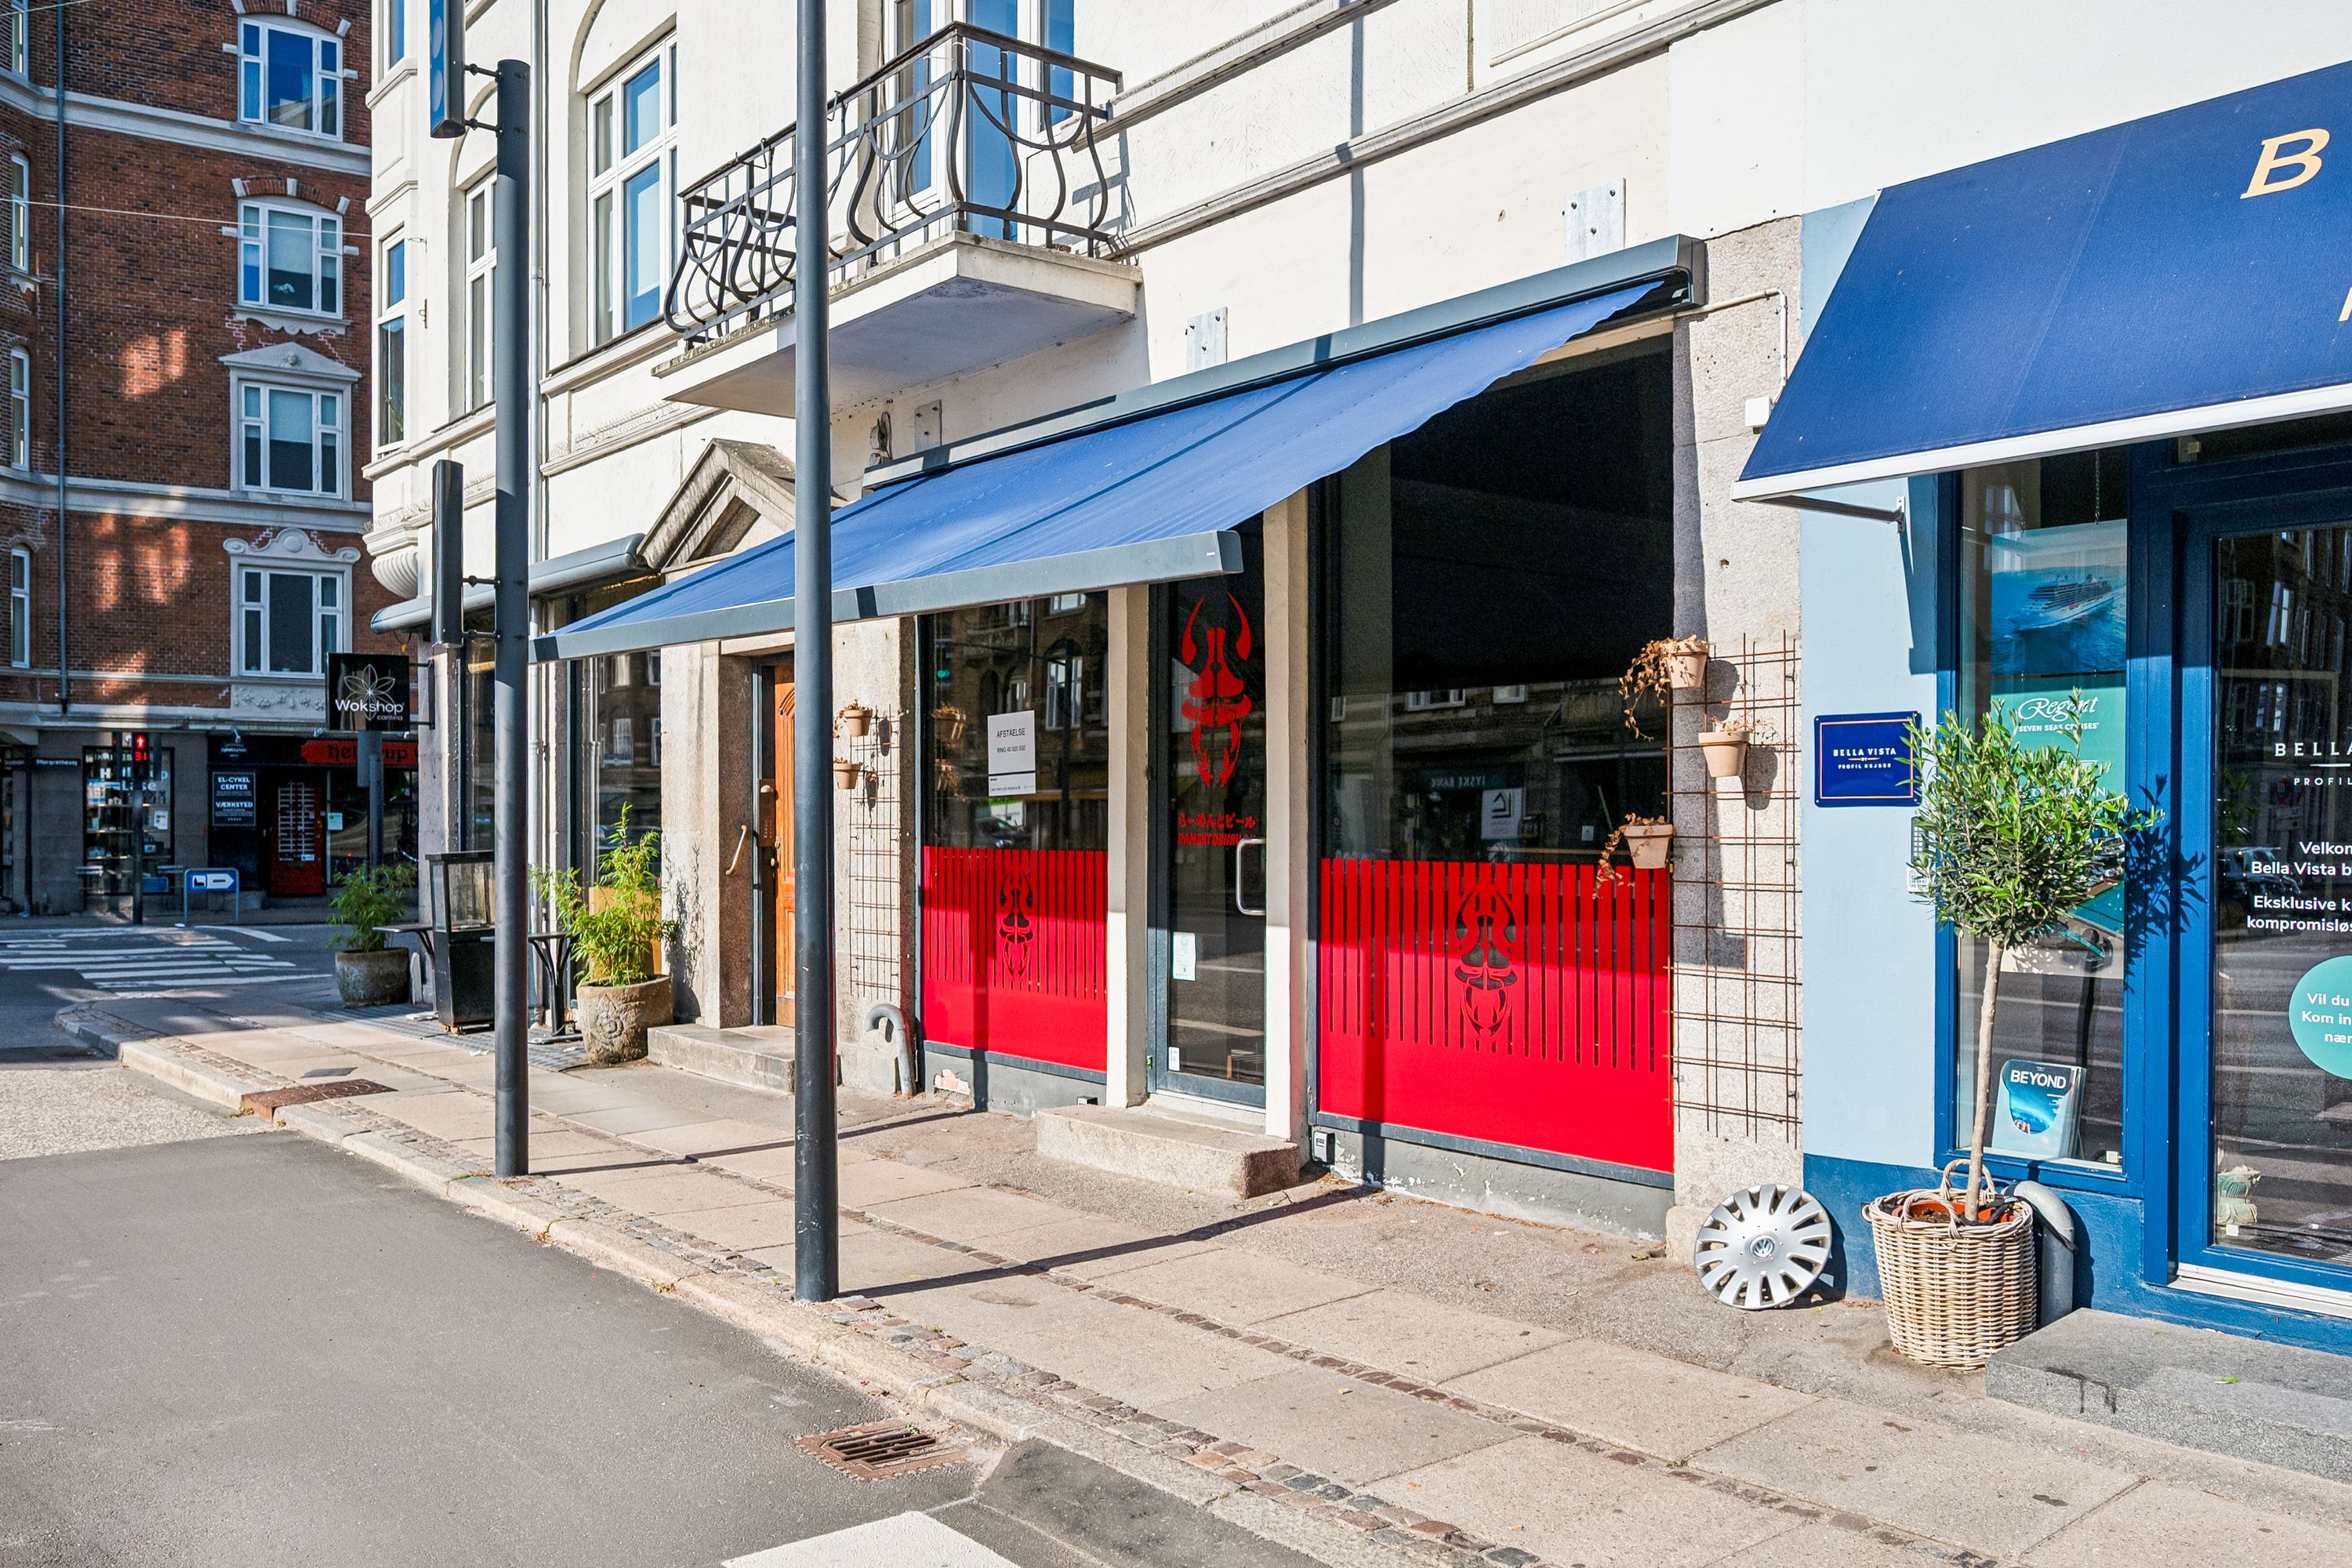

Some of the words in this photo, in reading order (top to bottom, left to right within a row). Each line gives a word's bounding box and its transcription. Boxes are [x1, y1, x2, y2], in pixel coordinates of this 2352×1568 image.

[335, 699, 405, 715] Wokshop
[2064, 722, 2100, 731] CRISES
[1833, 748, 1865, 757] BELLA
[1867, 747, 1896, 756] VISTA
[2251, 861, 2289, 875] Bella
[2293, 862, 2336, 876] Vista
[2254, 895, 2336, 911] Eksklusive
[2307, 993, 2327, 1005] Vil
[2331, 994, 2350, 1007] du
[2301, 1010, 2334, 1024] Kom
[2010, 1069, 2067, 1089] BEYOND
